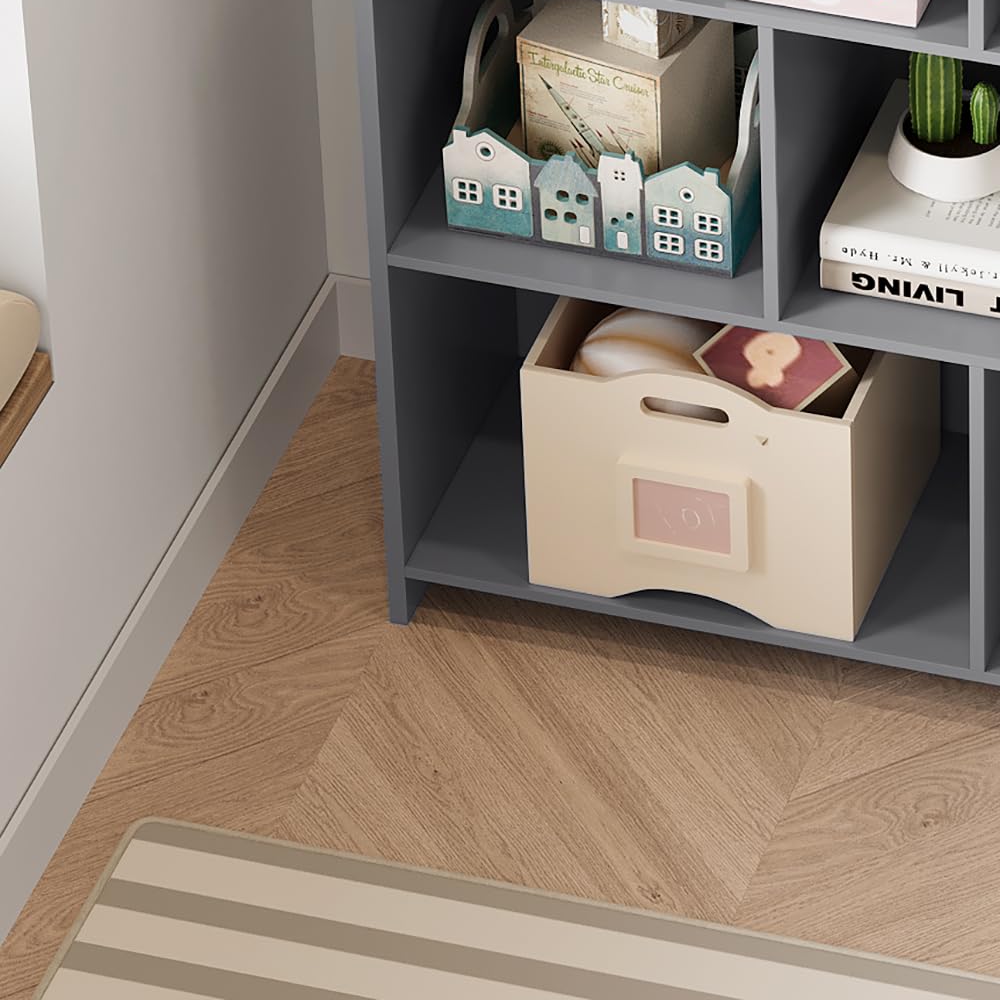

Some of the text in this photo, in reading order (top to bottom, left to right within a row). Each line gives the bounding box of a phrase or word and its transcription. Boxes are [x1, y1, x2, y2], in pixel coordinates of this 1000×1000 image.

[528, 51, 587, 77] Intergalactic
[586, 67, 611, 87] Star
[612, 75, 650, 98] Cruiser
[841, 246, 879, 261] Hyde
[887, 253, 913, 267] Mr.
[920, 259, 932, 269] &
[851, 271, 965, 307] LIVING
